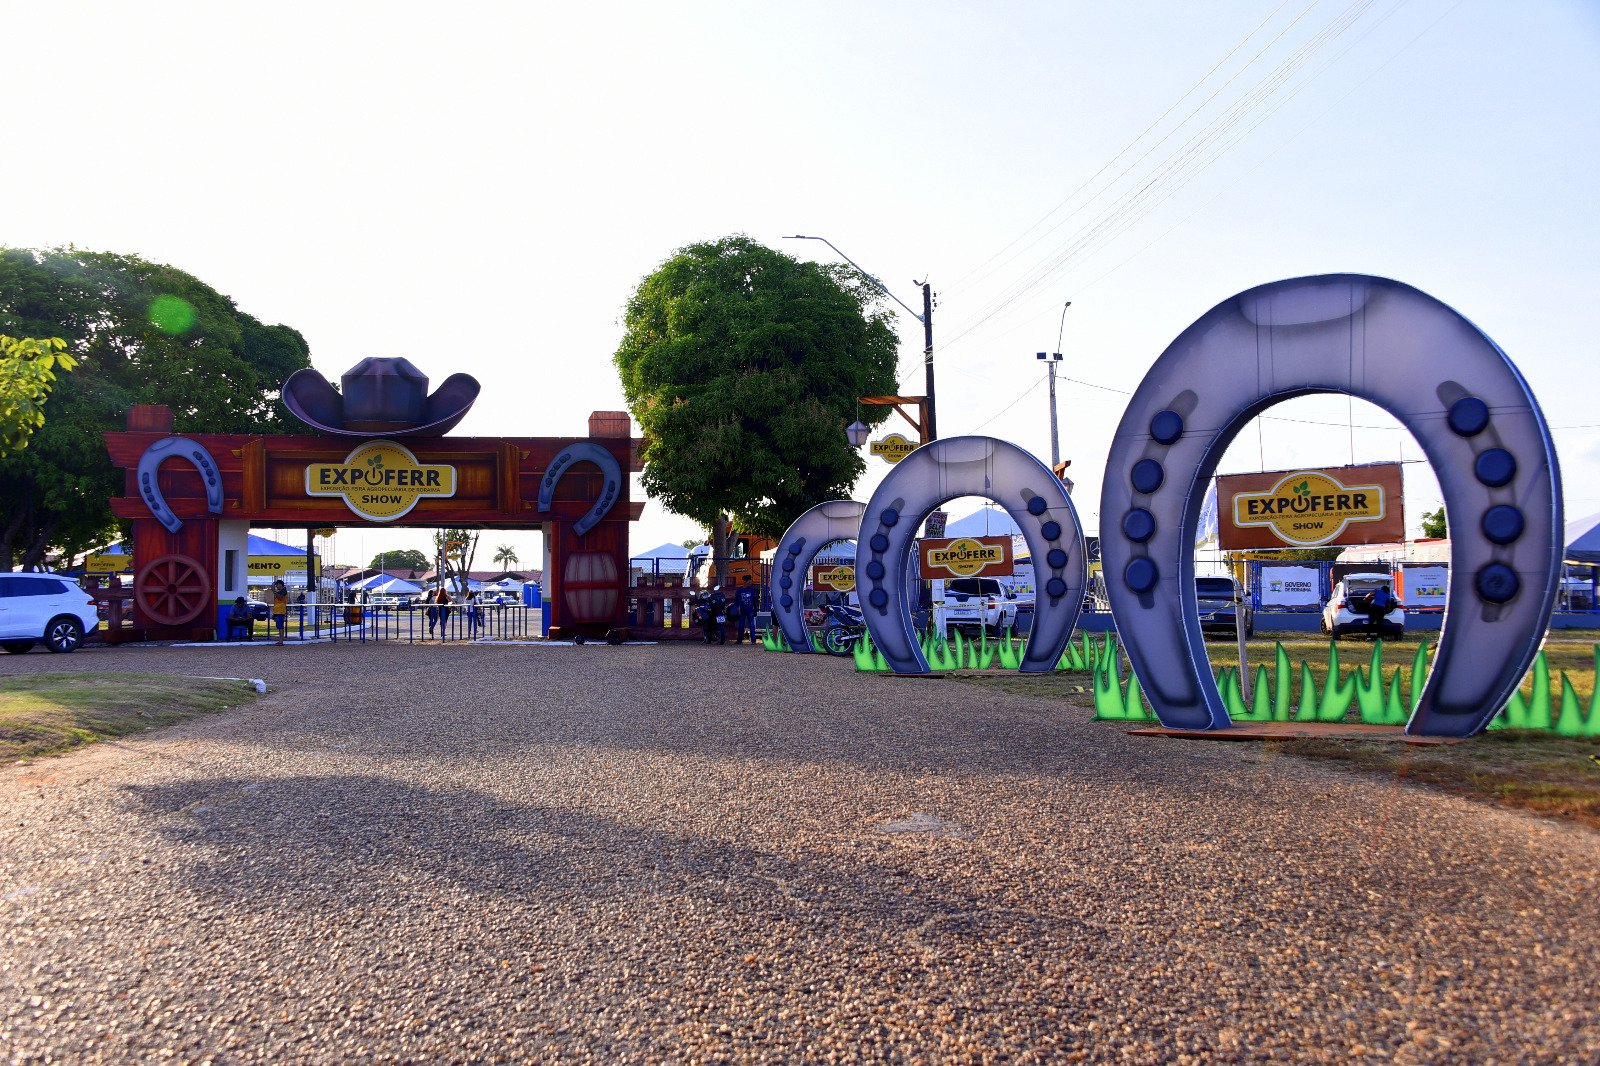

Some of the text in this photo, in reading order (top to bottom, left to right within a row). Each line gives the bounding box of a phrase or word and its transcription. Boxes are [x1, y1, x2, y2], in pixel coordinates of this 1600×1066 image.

[320, 467, 441, 486] EXPOFERR
[362, 495, 402, 504] SHOW
[1247, 493, 1369, 515] EXPOFERR
[1293, 522, 1324, 530] SHOW
[934, 549, 996, 561] EXPOFERR
